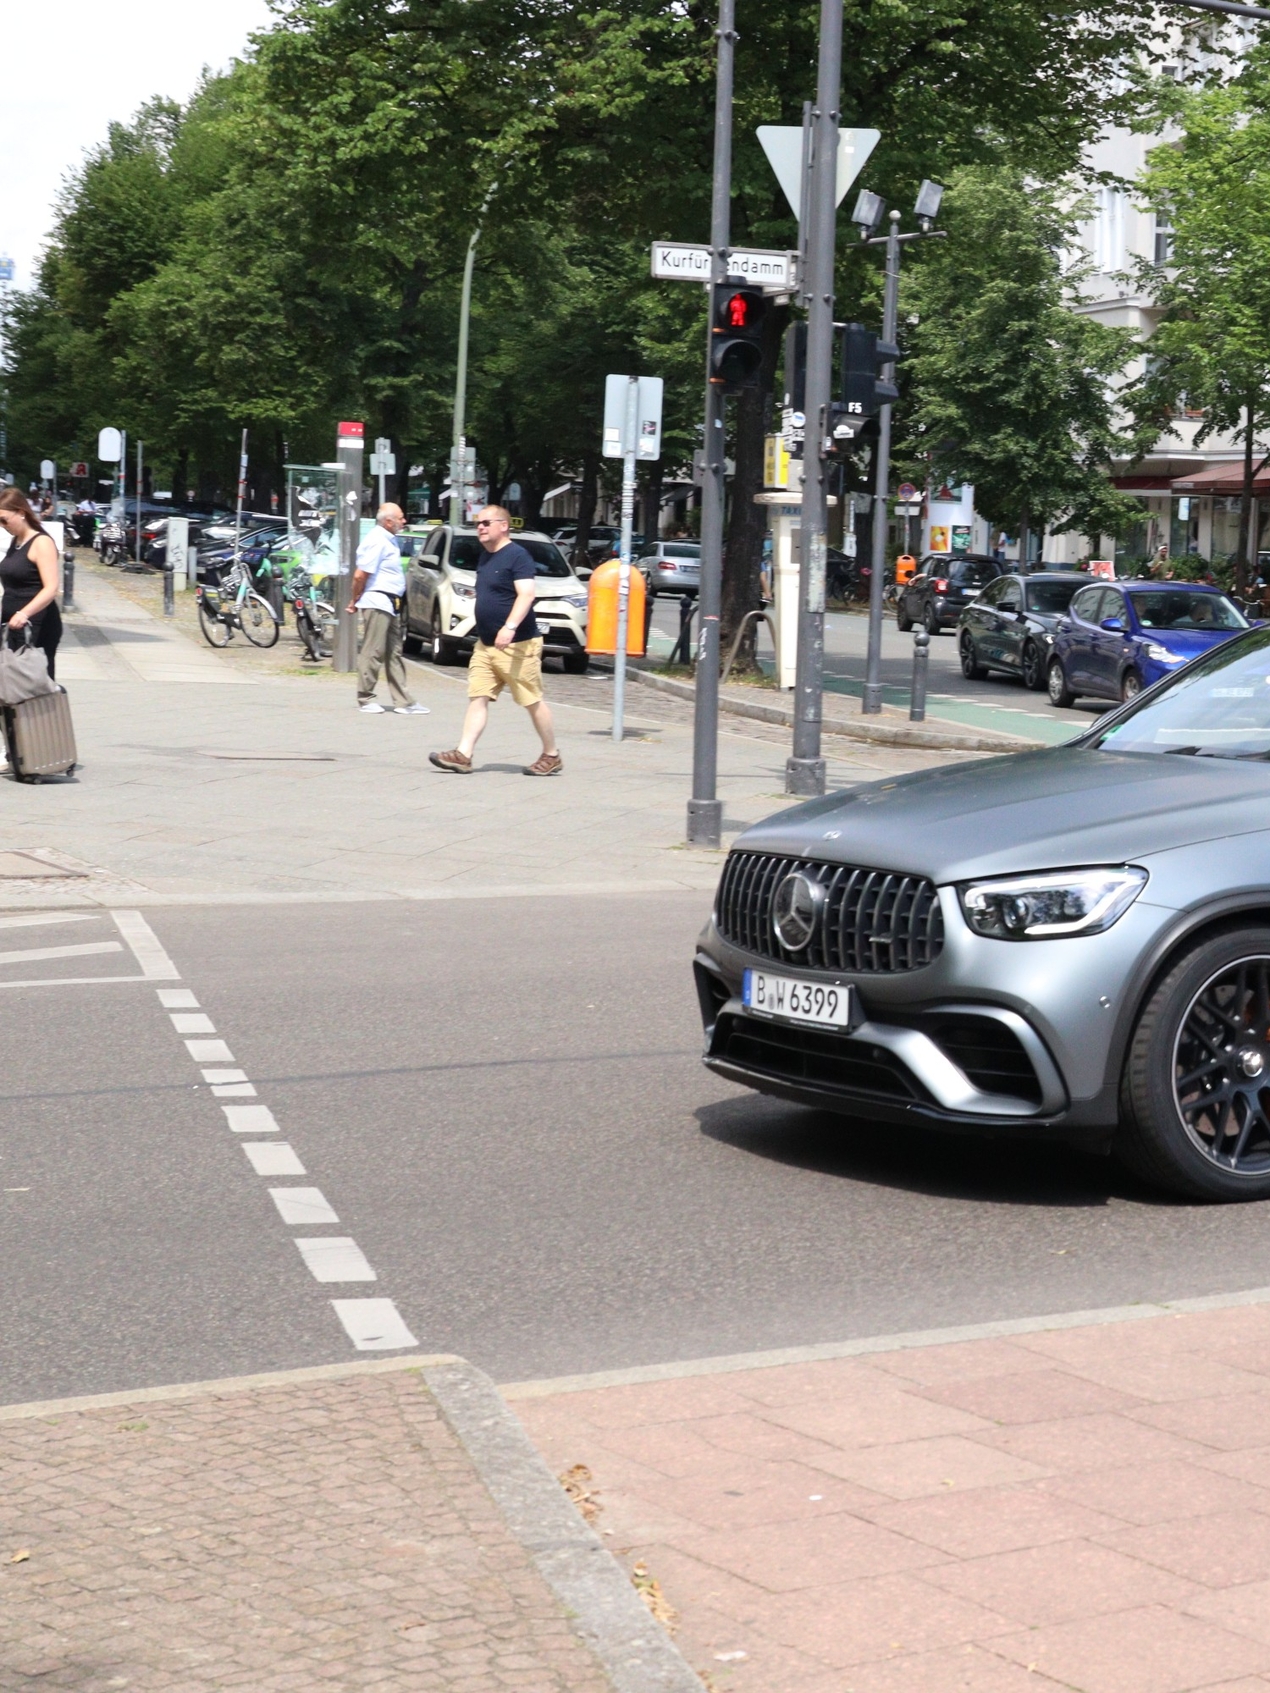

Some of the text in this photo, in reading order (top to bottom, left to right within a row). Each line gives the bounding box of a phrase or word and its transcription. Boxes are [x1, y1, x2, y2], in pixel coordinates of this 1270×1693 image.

[661, 250, 784, 276] Kurfürndamm
[848, 402, 862, 414] F5
[790, 983, 839, 1019] 6399
